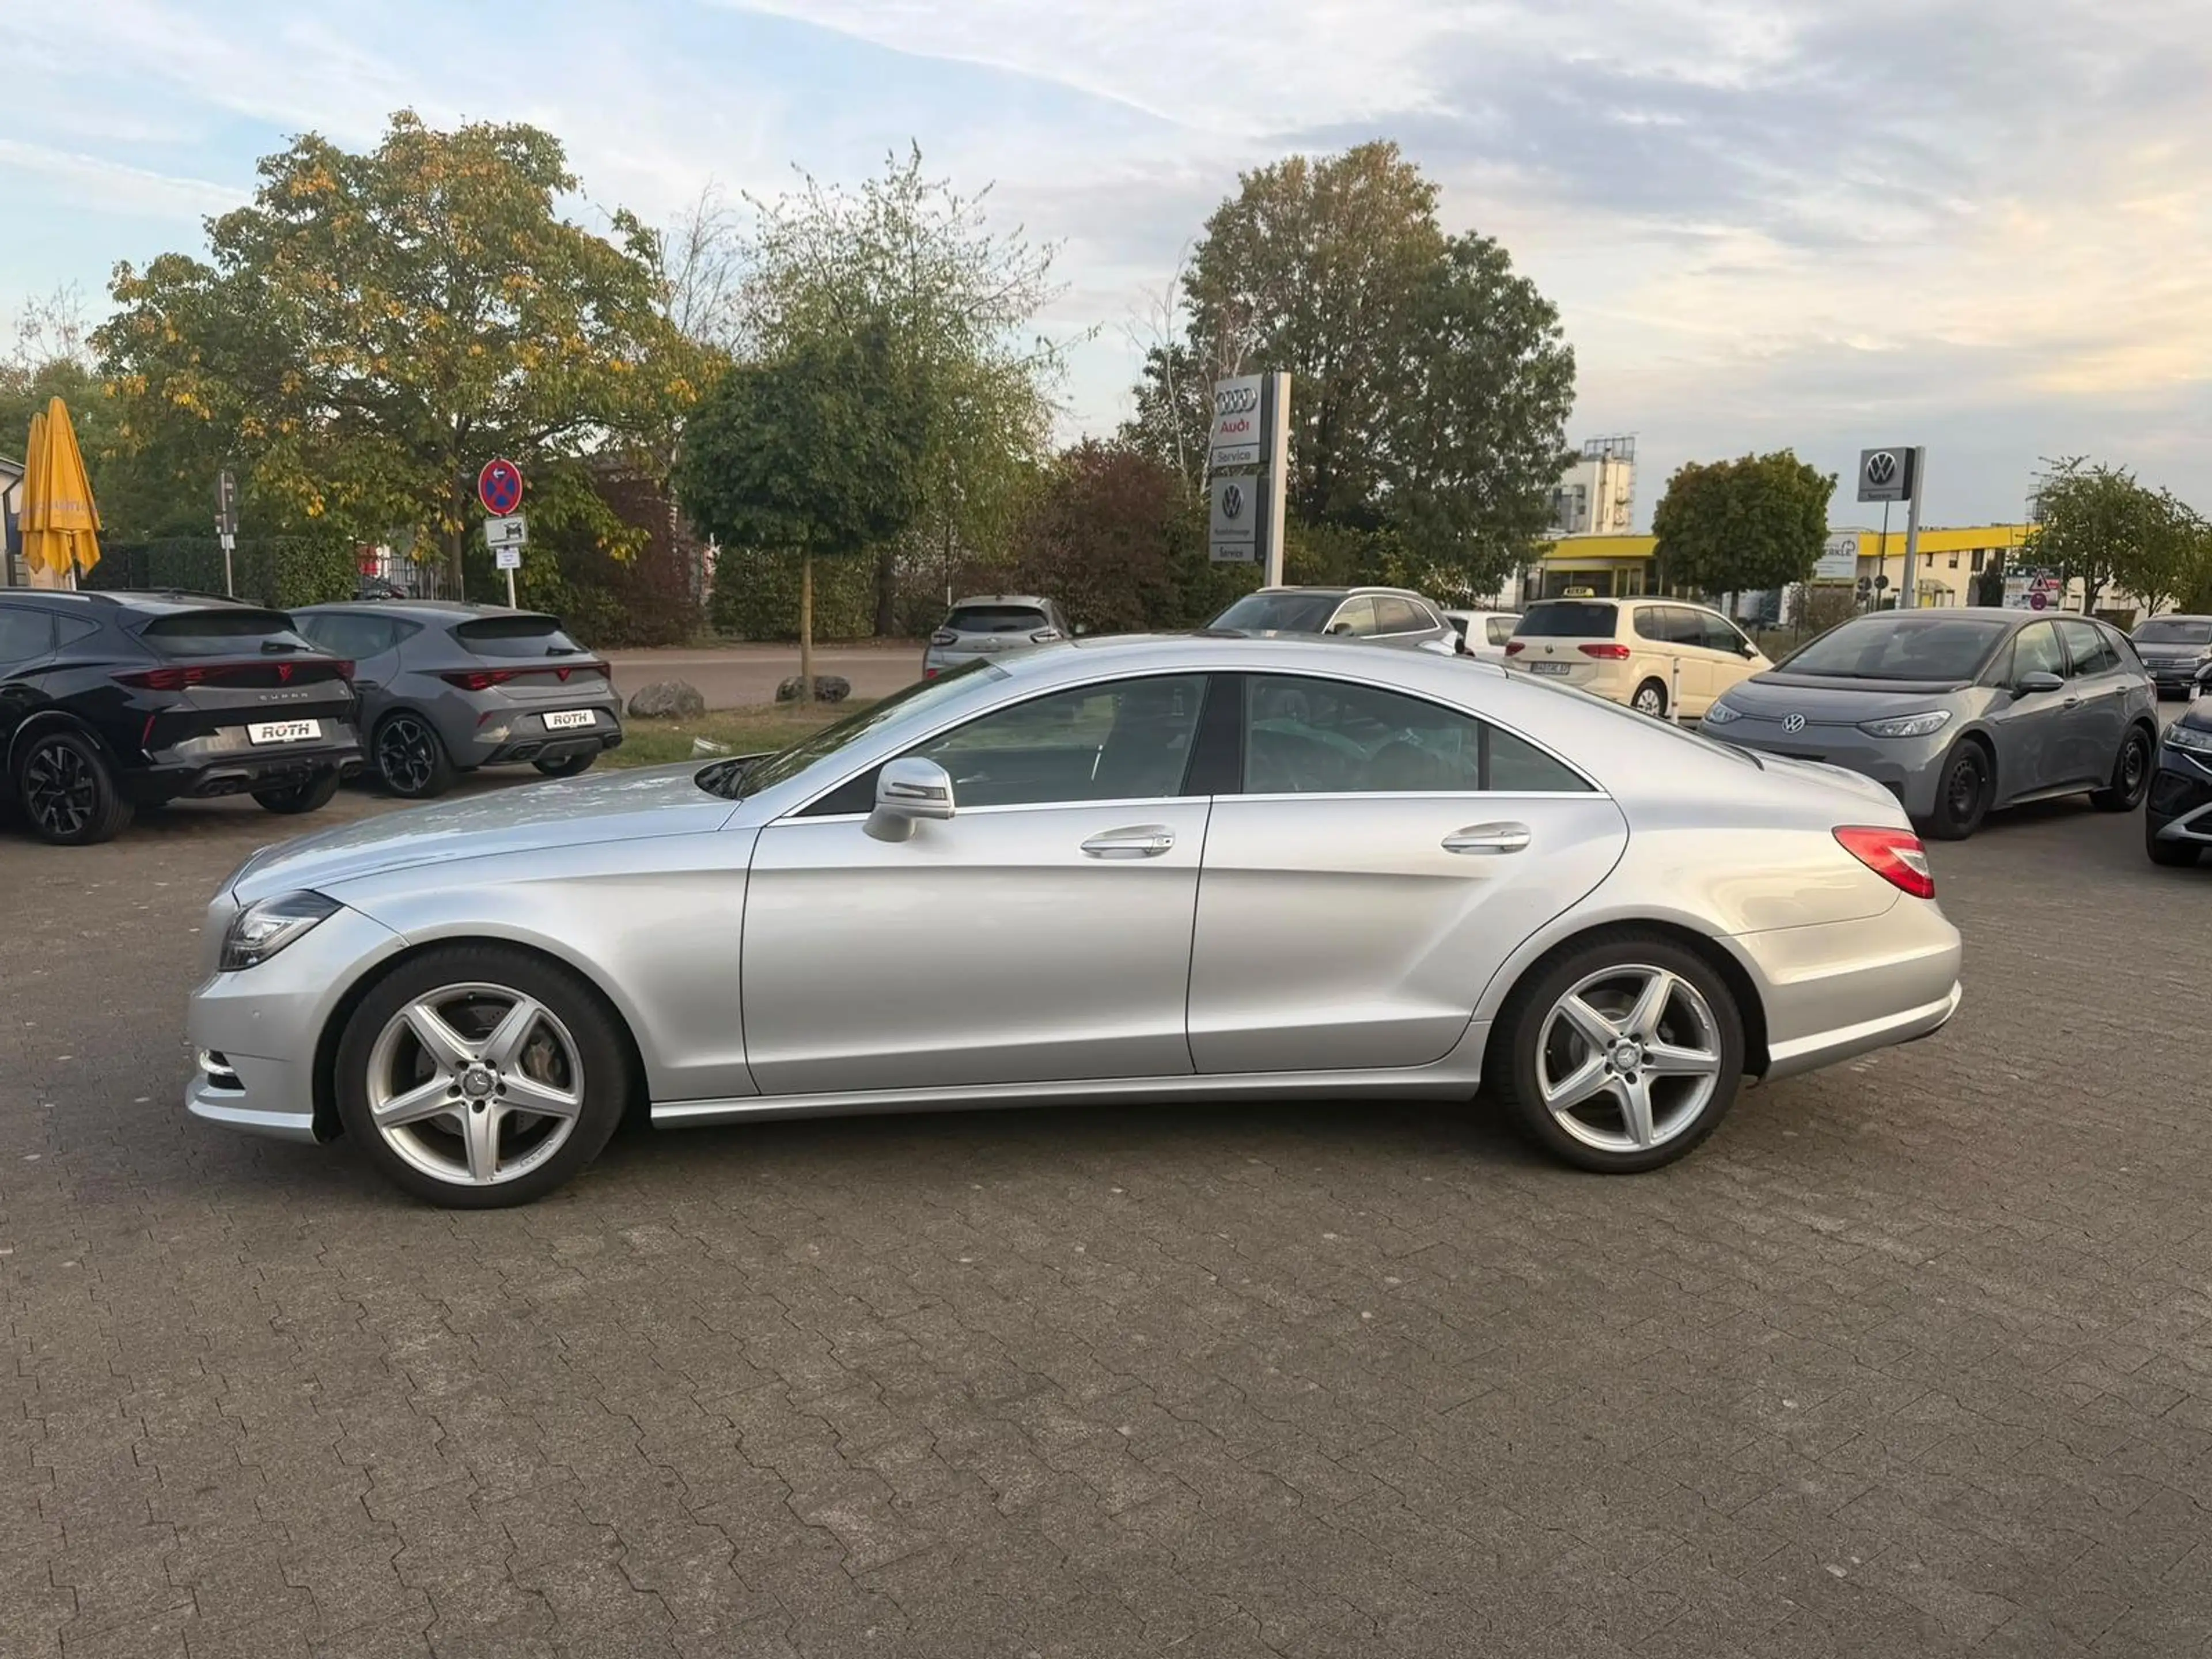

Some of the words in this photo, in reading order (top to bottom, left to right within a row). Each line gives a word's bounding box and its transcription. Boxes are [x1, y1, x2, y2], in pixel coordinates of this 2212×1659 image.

[1220, 418, 1249, 434] Audi
[1218, 449, 1251, 462] Service
[554, 712, 586, 725] ROTH
[262, 723, 309, 738] ROTH
